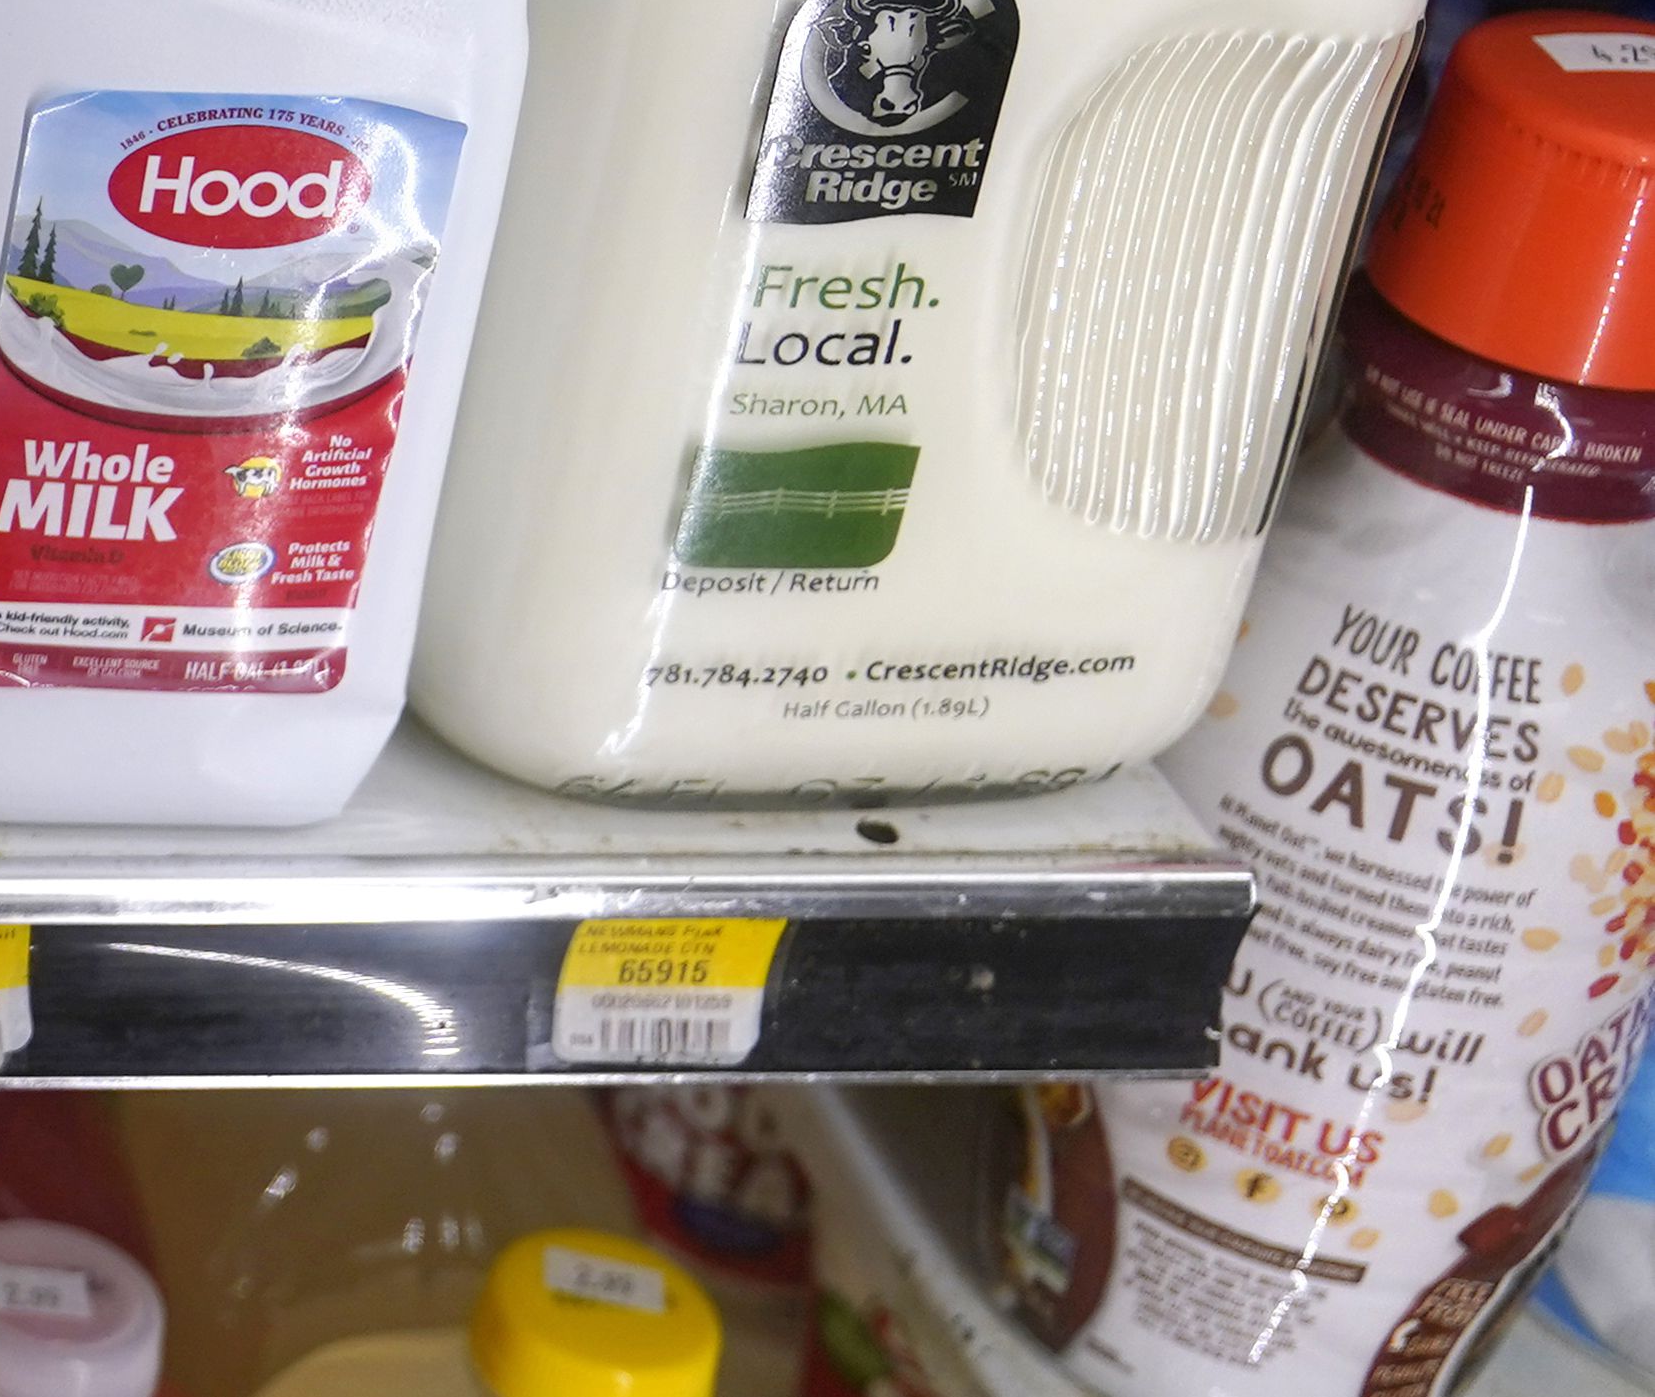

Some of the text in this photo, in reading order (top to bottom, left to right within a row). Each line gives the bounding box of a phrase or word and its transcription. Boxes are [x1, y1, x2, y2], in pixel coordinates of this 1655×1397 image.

[157, 107, 345, 135] CELEBRATING 175 YEARS
[769, 138, 985, 170] Crescent
[137, 156, 342, 217] Hood
[805, 170, 939, 209] Ridge
[752, 262, 941, 309] Fresh.
[733, 318, 914, 367] Local.
[729, 392, 908, 420] Sharon, MA
[300, 450, 370, 463] Artificial
[327, 437, 350, 448] No
[22, 438, 176, 484] Whole
[303, 465, 360, 478] Growth
[660, 571, 766, 596] Deposit
[789, 571, 880, 593] Return
[1332, 603, 1420, 677] YOUR
[646, 653, 1136, 688] 781.784.2740 CrescentRidge.com
[783, 697, 991, 721] Half Gallon (1.89L)
[1296, 654, 1540, 763] DESERVES
[1283, 696, 1536, 793] the awesomenss of
[1261, 732, 1524, 864] OATS!
[618, 958, 709, 984] 65915
[1395, 1029, 1486, 1065] will
[1348, 1066, 1438, 1103] us!
[1191, 1077, 1385, 1165] VISIT US
